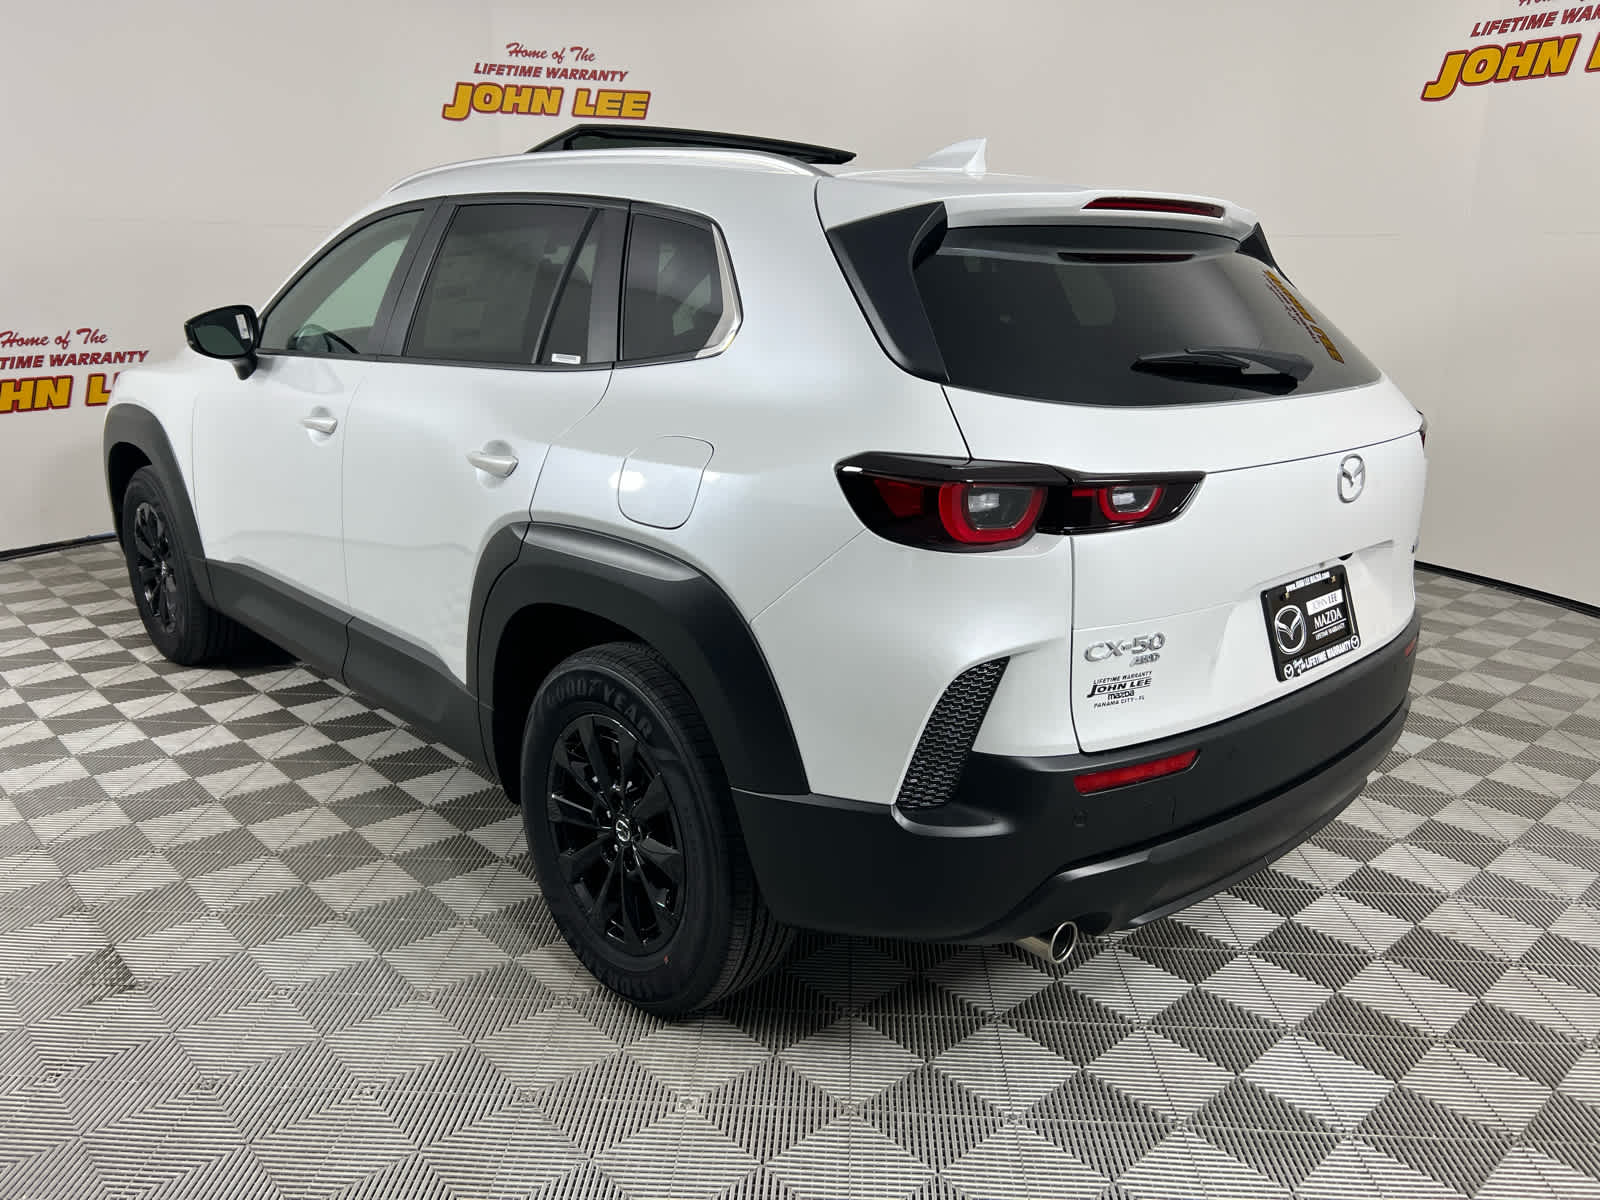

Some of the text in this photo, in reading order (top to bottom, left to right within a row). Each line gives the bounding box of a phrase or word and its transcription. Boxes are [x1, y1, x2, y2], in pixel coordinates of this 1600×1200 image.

[1470, 11, 1559, 38] LIFETIME
[505, 42, 595, 64] Home of The
[473, 62, 629, 82] LIFETIME WARRANTY
[1421, 33, 1582, 101] JOHN
[442, 81, 651, 121] JOHN LEE
[0, 328, 108, 350] Home of The
[49, 350, 149, 367] WARRANTY
[85, 371, 120, 406] L
[1314, 607, 1342, 630] MAZDA
[1084, 632, 1165, 662] CX-50
[1087, 677, 1152, 698] JOHN LEE
[1093, 670, 1152, 685] LIFETIME WARRANTY
